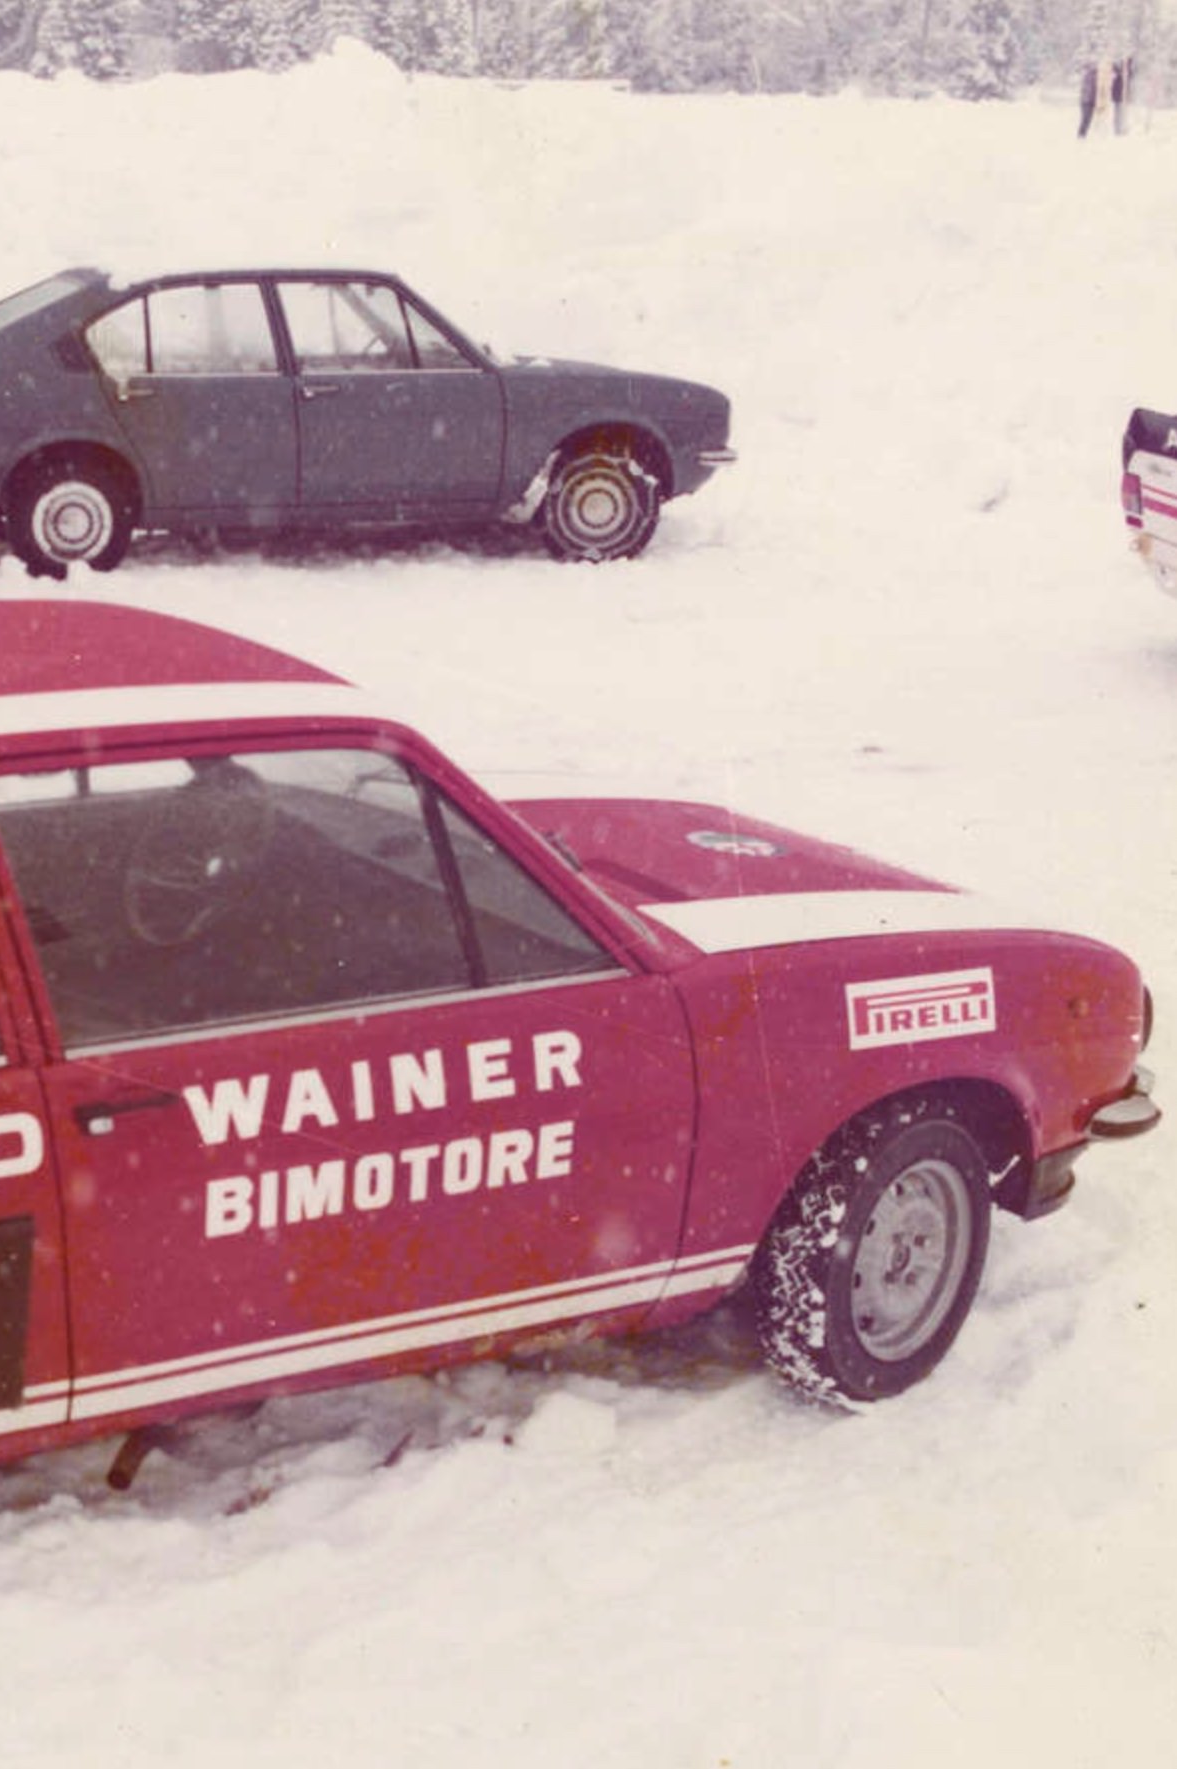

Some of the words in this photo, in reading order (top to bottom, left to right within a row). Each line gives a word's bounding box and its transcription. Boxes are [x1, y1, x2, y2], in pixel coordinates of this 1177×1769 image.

[853, 981, 989, 1036] PIRELLI
[184, 1030, 582, 1145] WAINER
[205, 1121, 575, 1238] BIMOTORE
